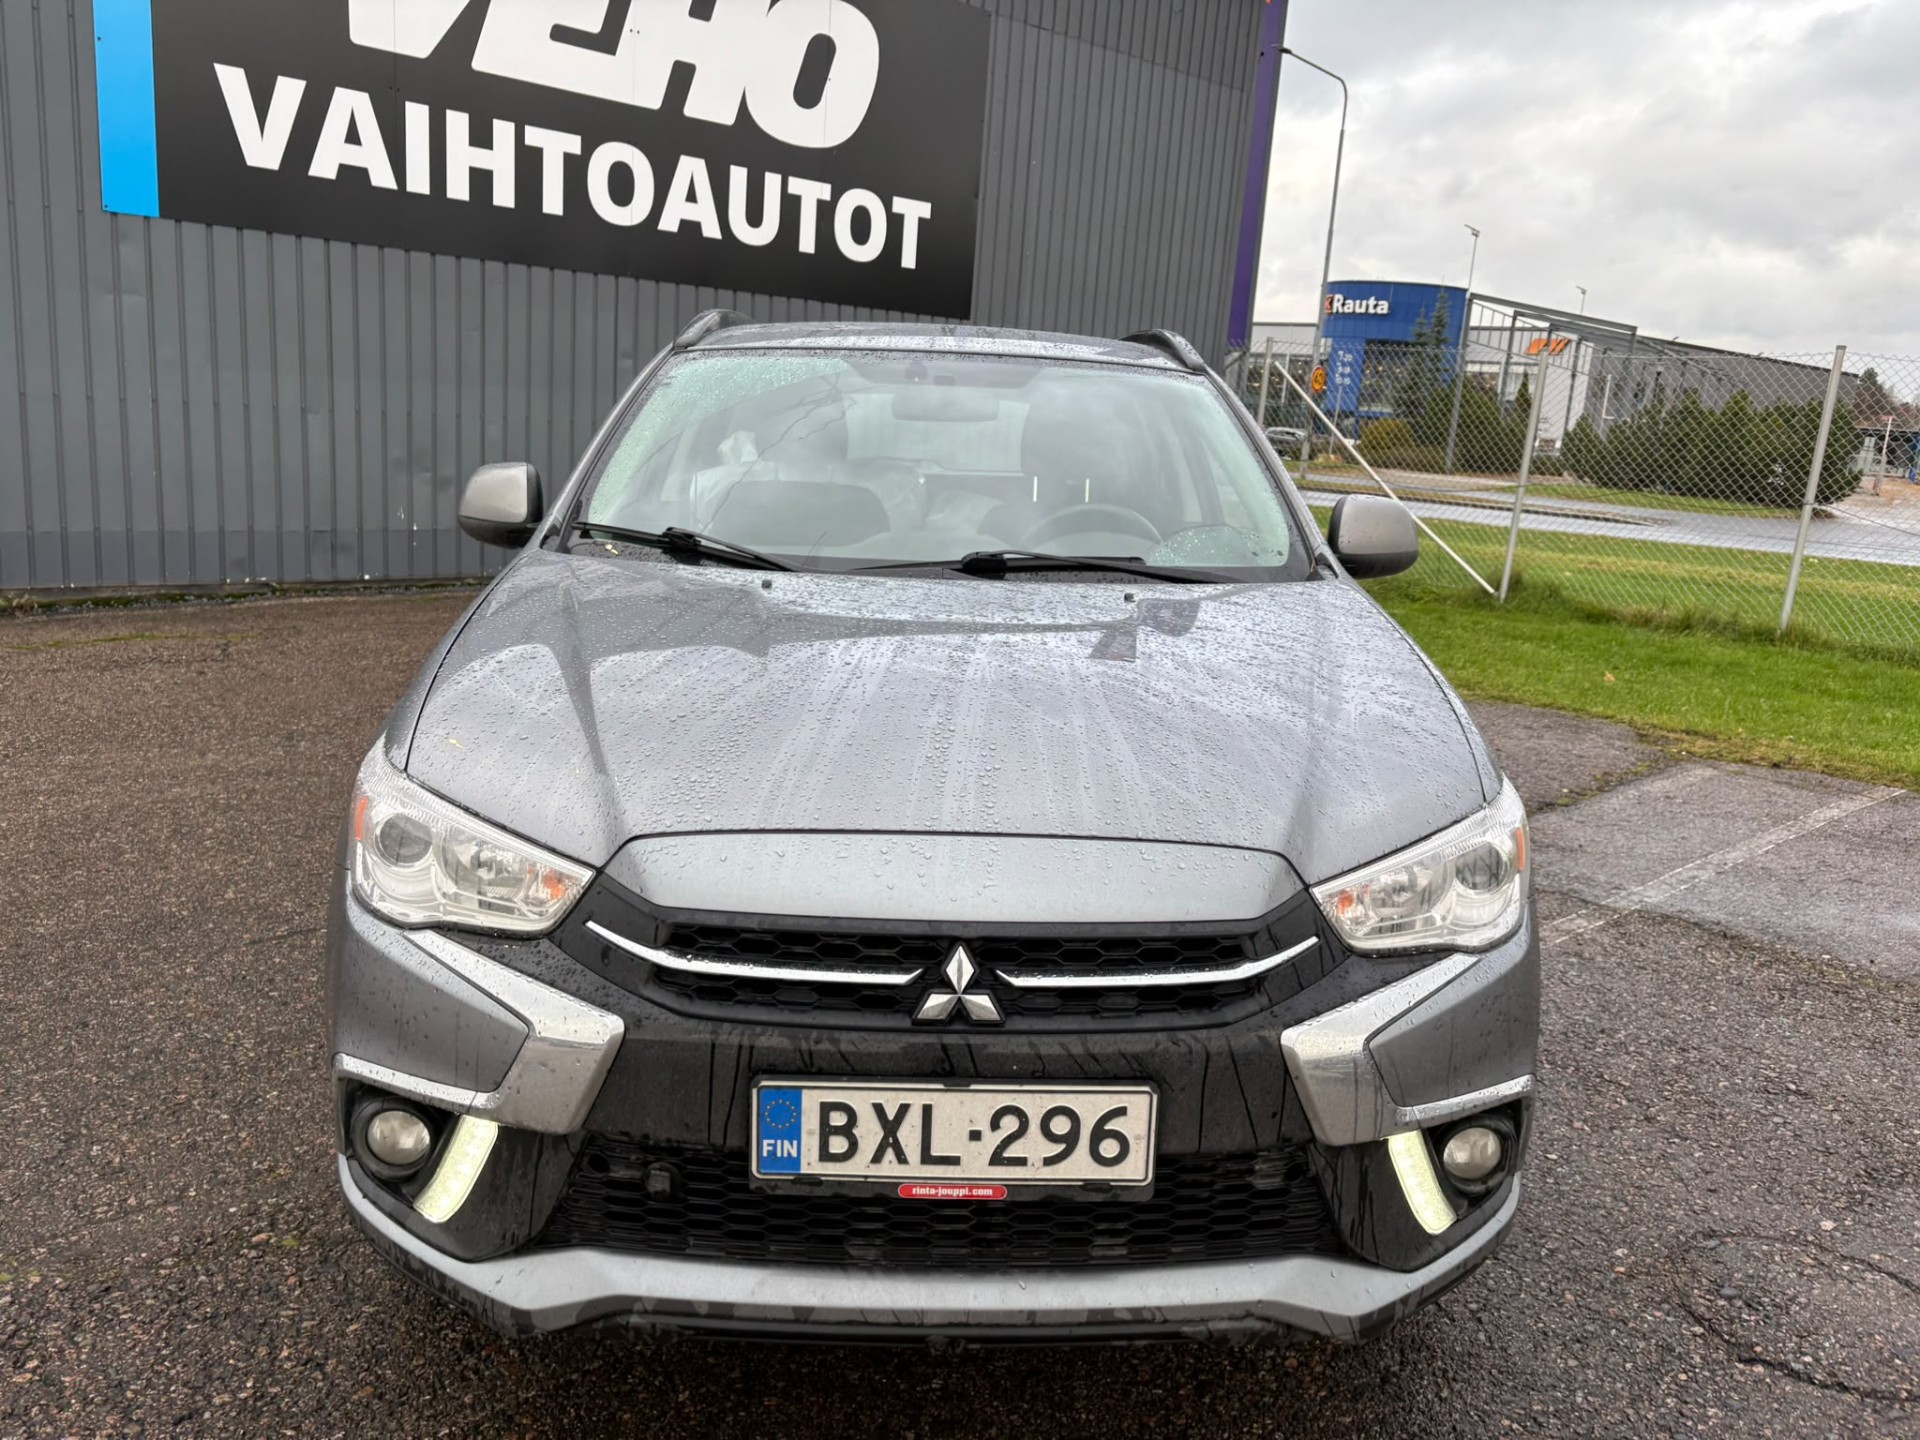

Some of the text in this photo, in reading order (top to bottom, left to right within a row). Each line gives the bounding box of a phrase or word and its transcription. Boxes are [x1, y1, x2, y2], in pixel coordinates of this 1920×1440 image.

[213, 63, 932, 269] VAIHTOAUTOT
[762, 1139, 798, 1158] FIN
[912, 1186, 993, 1196] rinta-jouppi.com
